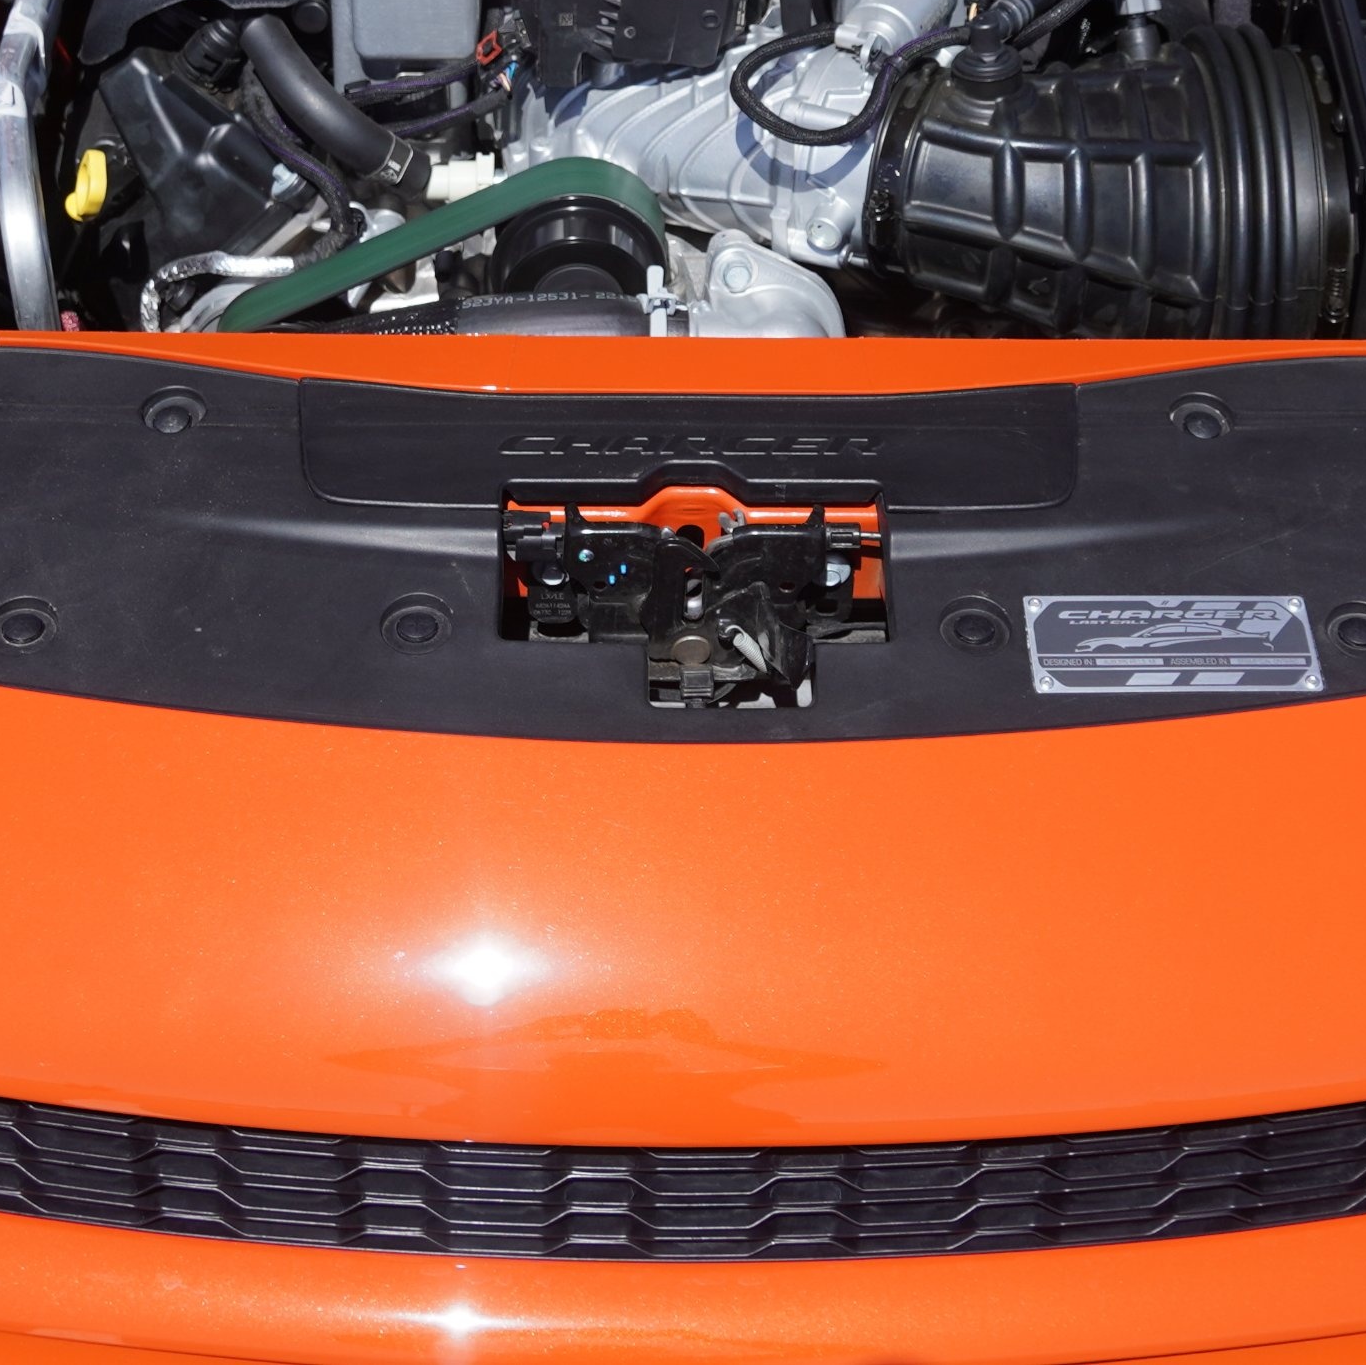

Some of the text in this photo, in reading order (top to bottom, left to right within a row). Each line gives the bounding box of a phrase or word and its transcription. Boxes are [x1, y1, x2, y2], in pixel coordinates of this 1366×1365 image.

[497, 435, 884, 456] CHARGER
[1058, 609, 1281, 621] CHARGER
[1043, 658, 1082, 666] DESIGNED
